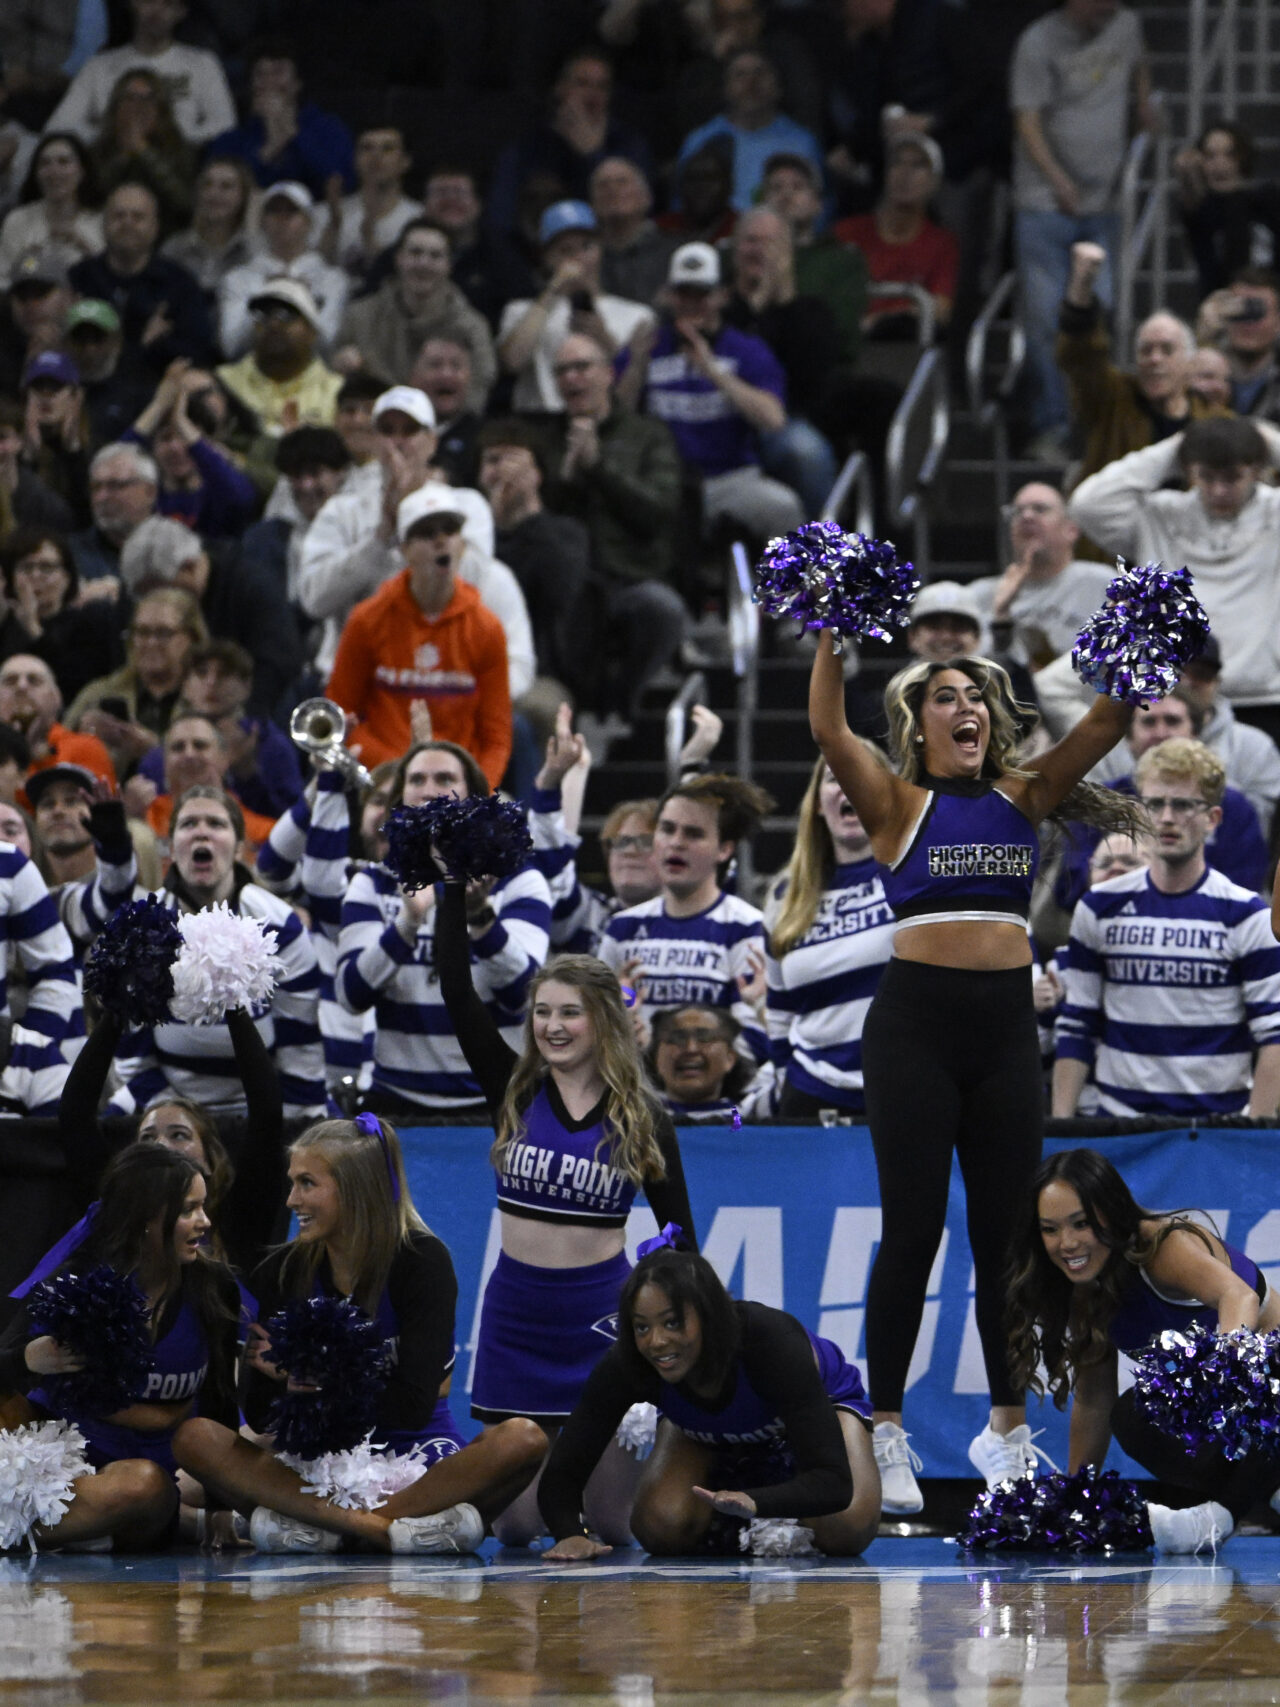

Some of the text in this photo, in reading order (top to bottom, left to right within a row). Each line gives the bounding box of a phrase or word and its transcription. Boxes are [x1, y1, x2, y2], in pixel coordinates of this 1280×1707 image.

[928, 844, 1033, 863] HIGH POINT
[929, 860, 1032, 877] UNIVERSITY
[1105, 923, 1229, 950] HIGH POINT
[665, 946, 722, 970] POINT
[503, 1143, 630, 1200] HIGH POINT
[502, 1175, 622, 1211] UNIVERSITY
